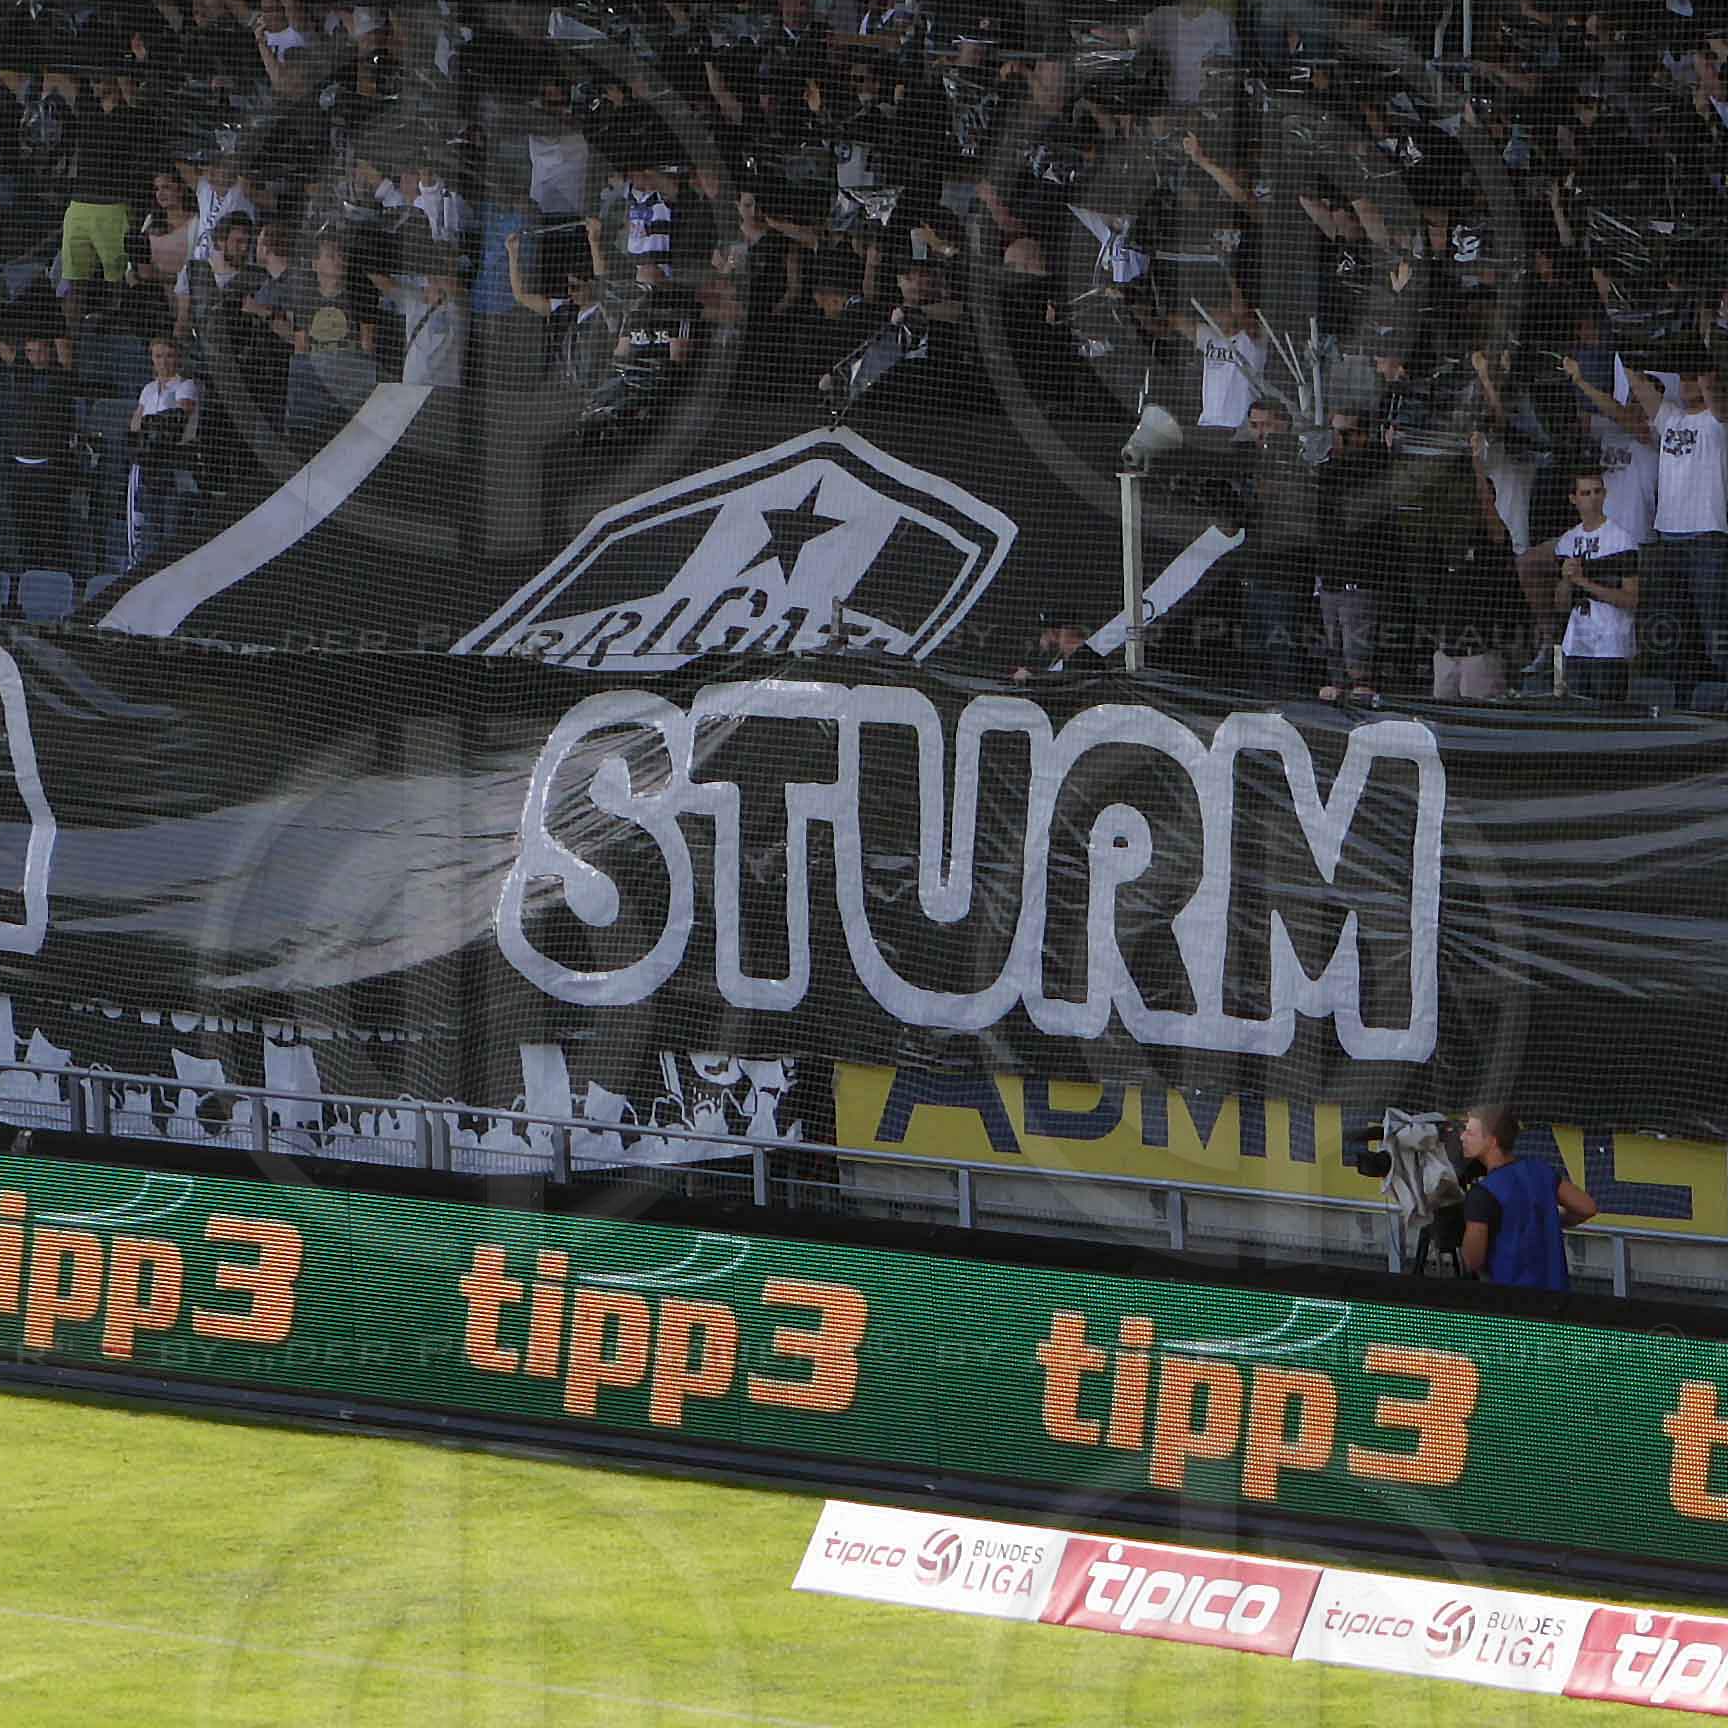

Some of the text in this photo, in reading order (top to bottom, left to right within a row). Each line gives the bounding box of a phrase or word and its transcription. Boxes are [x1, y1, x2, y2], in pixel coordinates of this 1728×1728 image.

[495, 678, 1446, 1062] STURM
[459, 1242, 868, 1428] tipp3
[1035, 1310, 1479, 1501] tipp3
[823, 1530, 908, 1569] tipico
[971, 1538, 1046, 1566] BUNDES
[961, 1559, 1036, 1598] LIGA
[1084, 1542, 1282, 1636] tipico
[1323, 1600, 1415, 1641] tipico
[1485, 1610, 1568, 1639] BUNDES
[1474, 1635, 1558, 1672] LIGA
